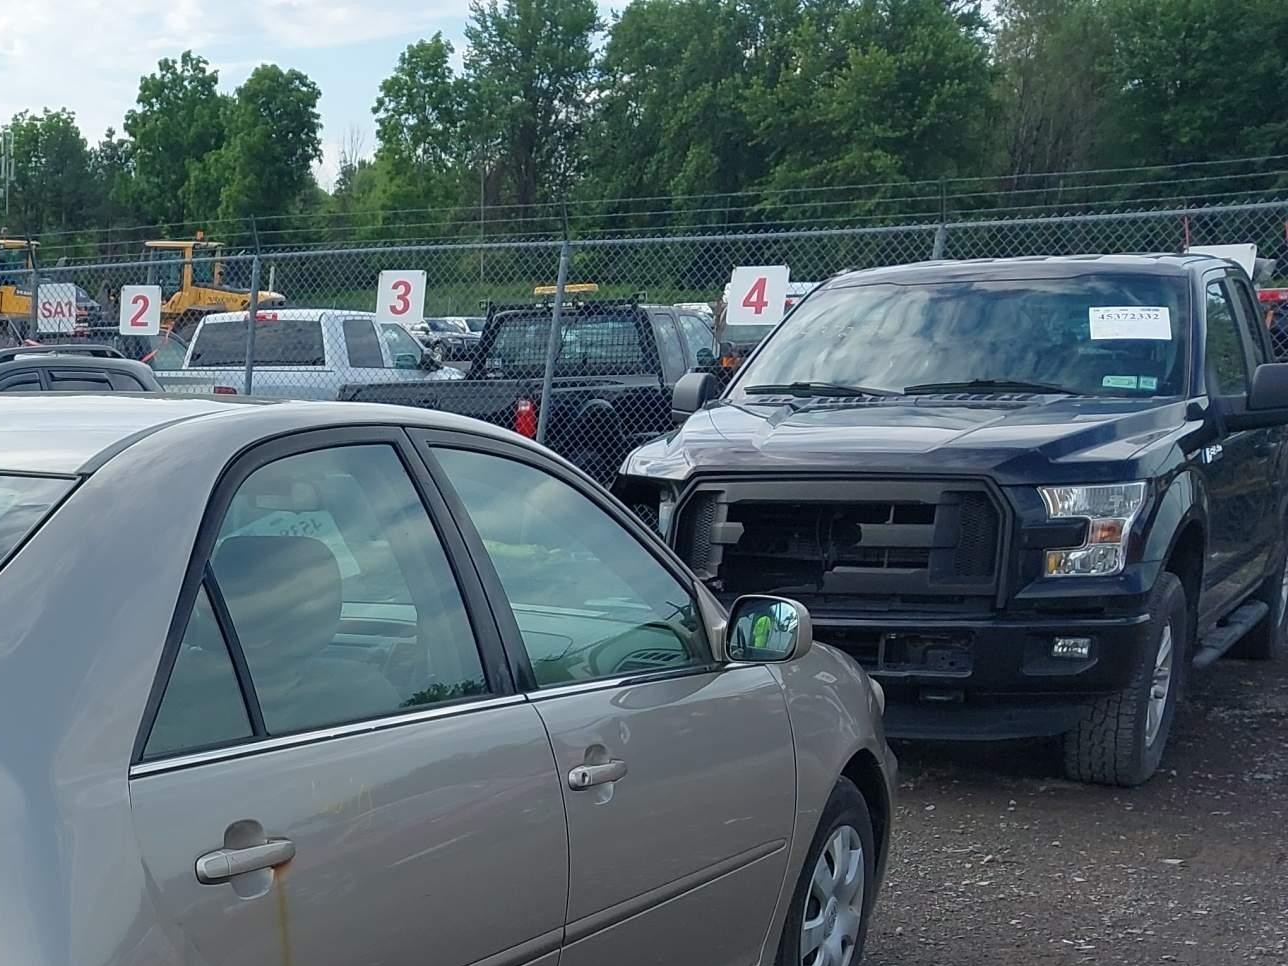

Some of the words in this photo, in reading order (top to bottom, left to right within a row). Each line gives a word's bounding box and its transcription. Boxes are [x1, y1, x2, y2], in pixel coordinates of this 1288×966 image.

[40, 300, 74, 319] SA1
[130, 294, 150, 326] 2
[389, 280, 411, 315] 3
[742, 278, 768, 314] 4
